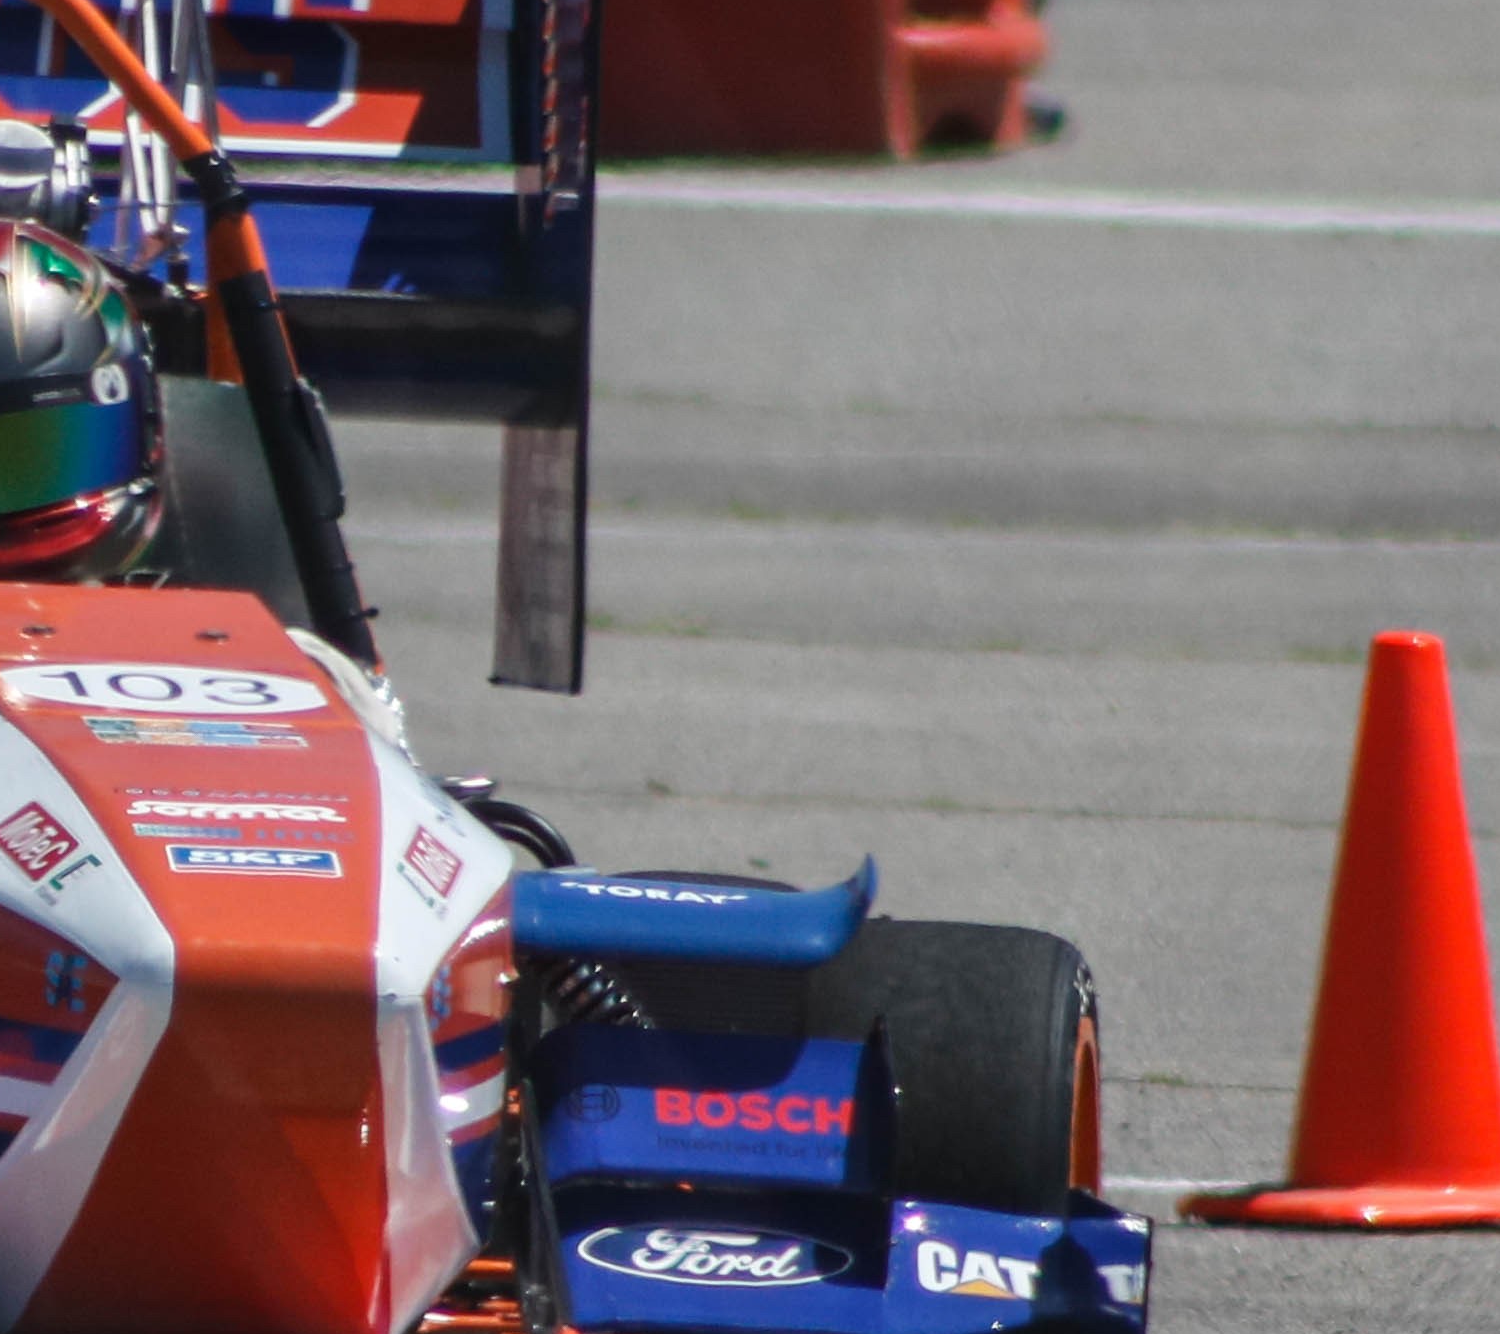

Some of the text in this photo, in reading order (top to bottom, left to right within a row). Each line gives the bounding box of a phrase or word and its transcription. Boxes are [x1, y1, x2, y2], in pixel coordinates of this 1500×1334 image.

[41, 671, 280, 706] 103
[187, 845, 324, 865] SKF
[580, 883, 730, 905] TORAY
[655, 1088, 853, 1135] BOSCH
[631, 1228, 801, 1278] Ford
[917, 1240, 1040, 1300] CAT
